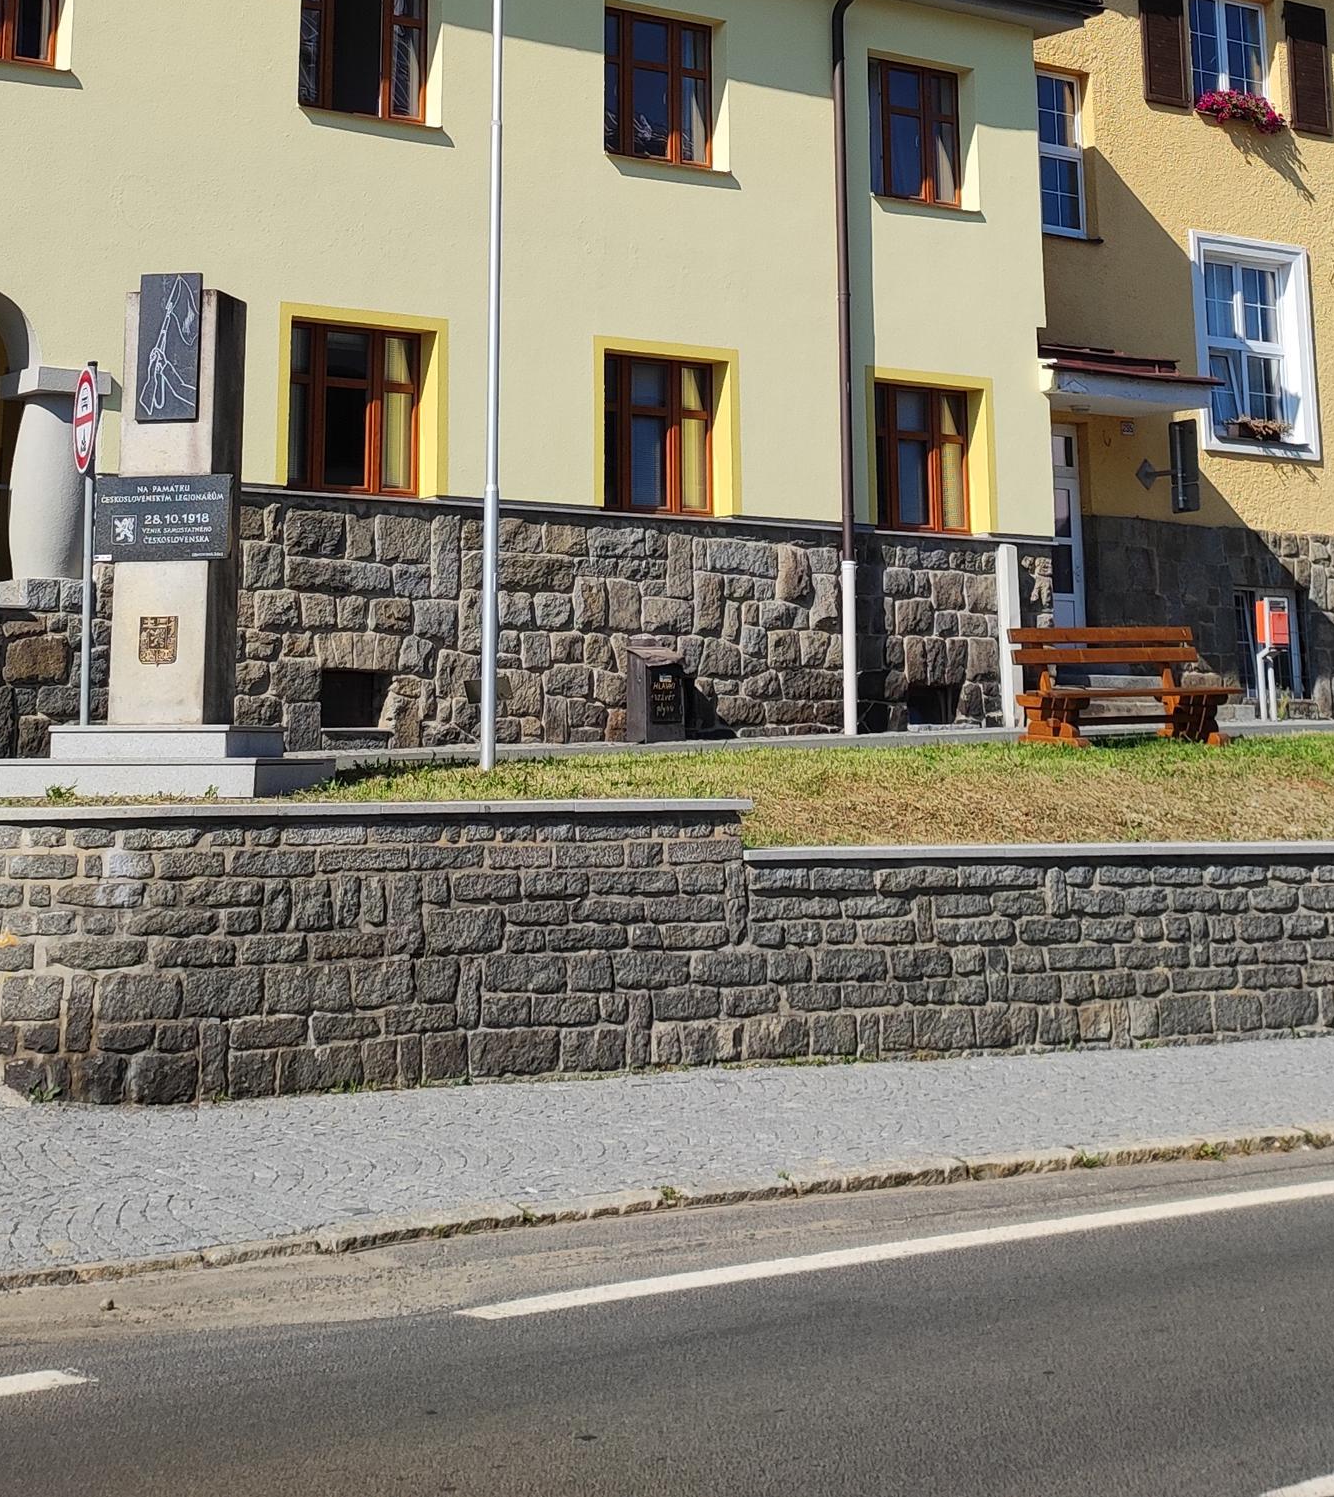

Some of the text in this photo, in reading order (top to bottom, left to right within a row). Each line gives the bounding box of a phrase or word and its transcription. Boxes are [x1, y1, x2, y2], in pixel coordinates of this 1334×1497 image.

[152, 484, 190, 492] PAMÁTKU
[144, 513, 210, 525] 28.10.1918
[142, 535, 210, 544] ČESKOSLOVENSKA
